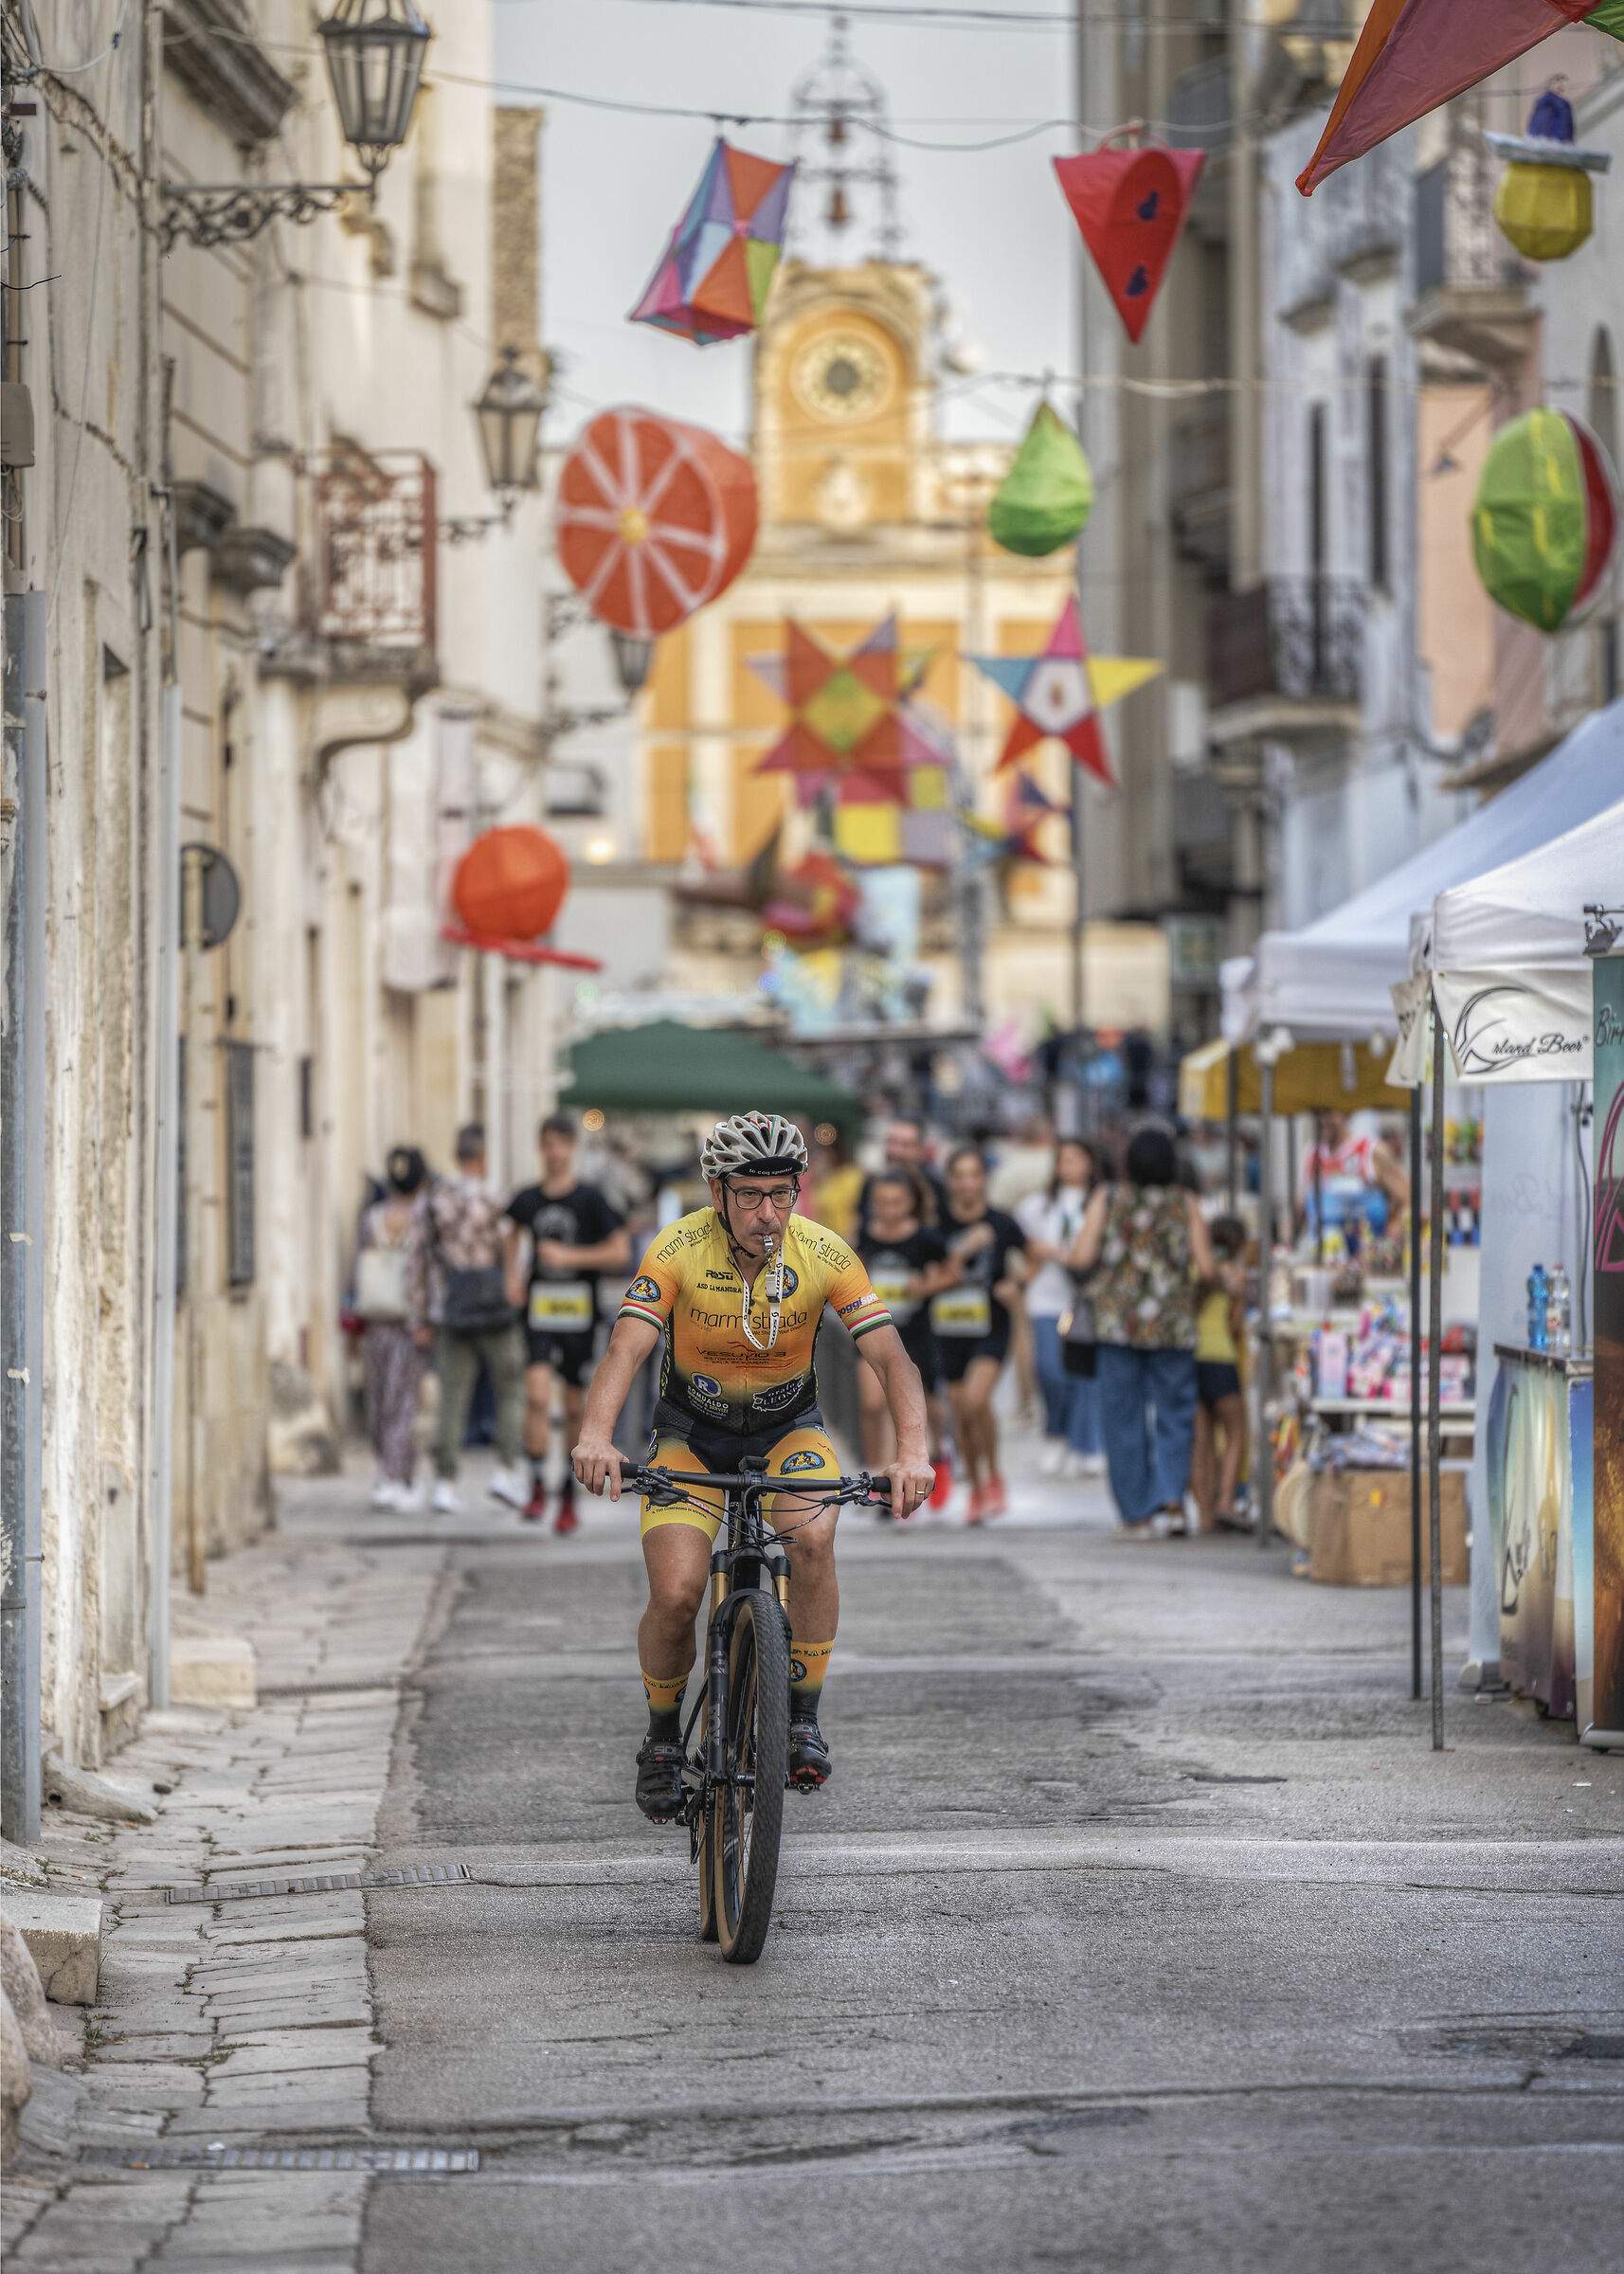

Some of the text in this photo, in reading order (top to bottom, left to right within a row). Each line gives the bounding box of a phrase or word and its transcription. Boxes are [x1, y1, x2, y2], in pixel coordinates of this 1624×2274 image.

[715, 1286, 743, 1294] MANDRA
[690, 1308, 807, 1330] marmstrada
[687, 1384, 729, 1410] ROMUALDO
